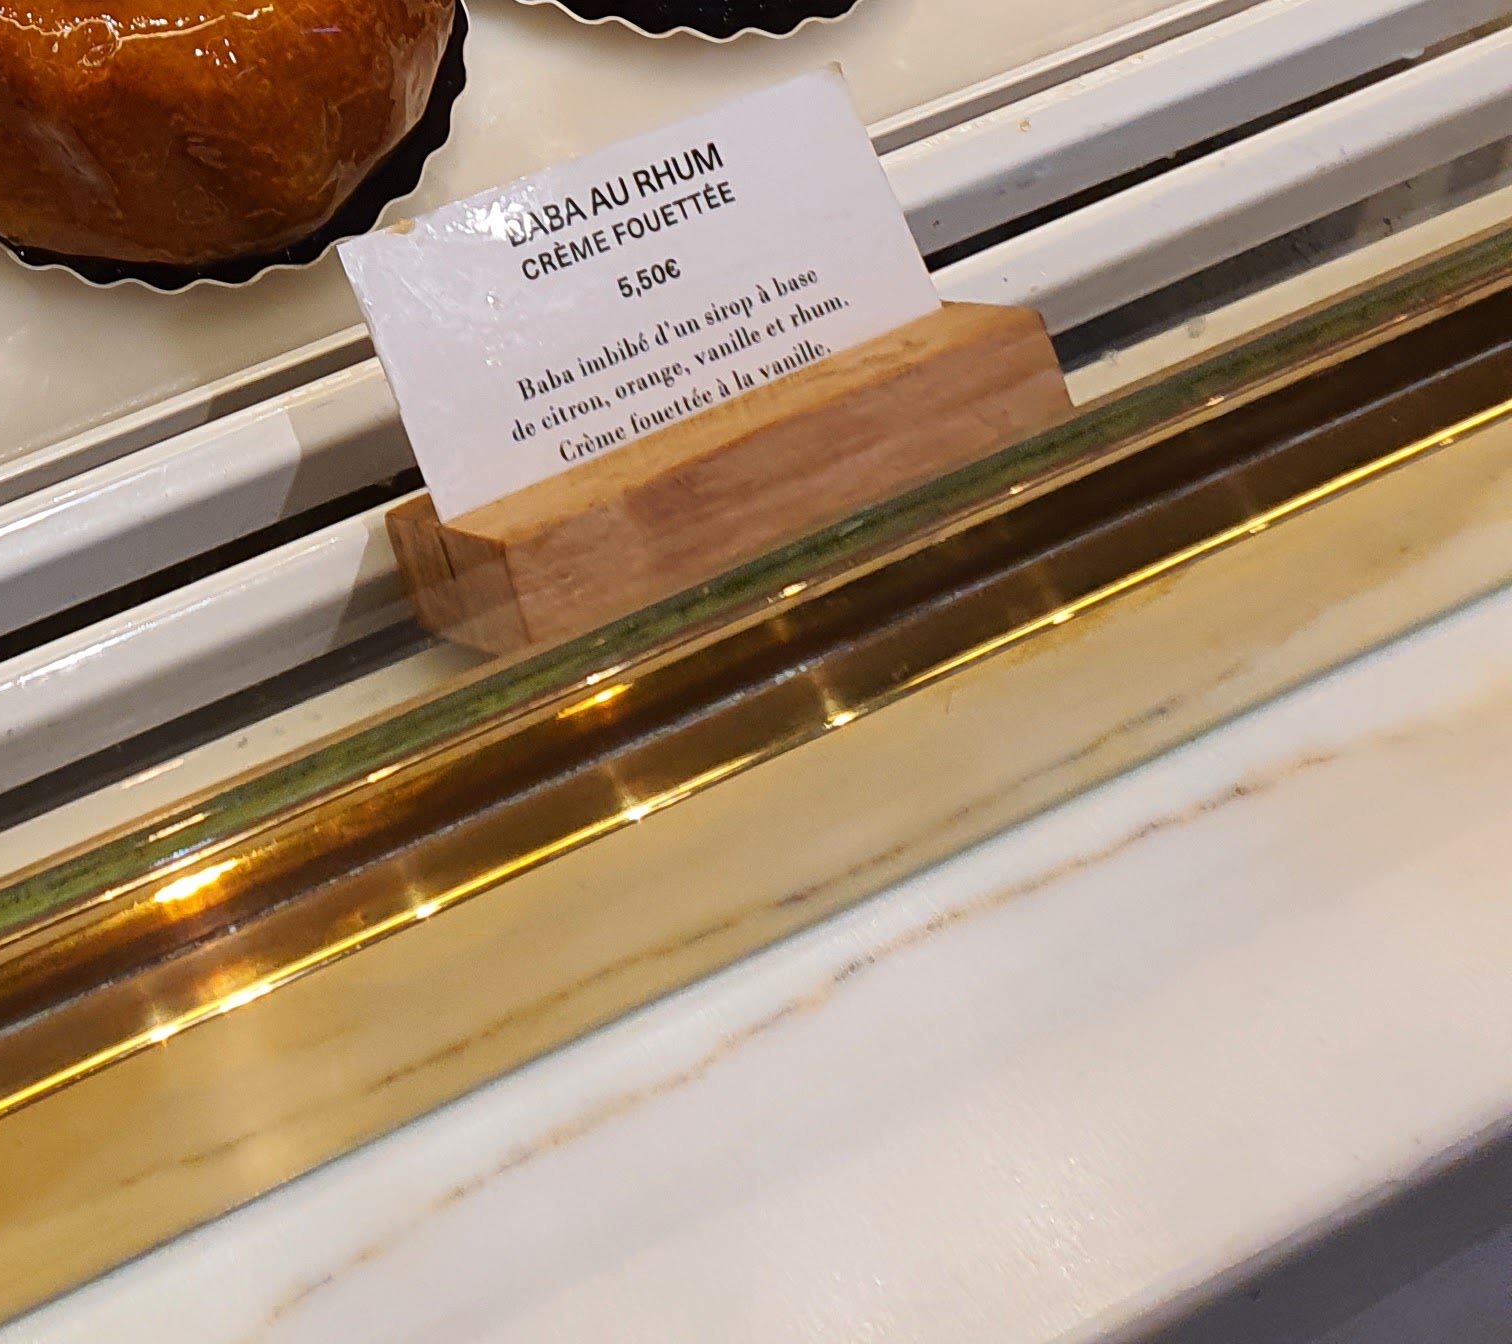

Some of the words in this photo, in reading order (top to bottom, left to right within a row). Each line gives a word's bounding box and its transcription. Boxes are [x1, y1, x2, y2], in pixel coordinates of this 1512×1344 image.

[521, 230, 611, 281] CRÈME
[612, 181, 737, 246] FOUETTÉE
[591, 176, 630, 216] AU
[633, 142, 724, 198] RHUM
[617, 258, 682, 299] 5,50€
[511, 419, 537, 442] de
[541, 395, 612, 431] citron,
[615, 362, 691, 400] orange,
[694, 326, 761, 366] vanille
[766, 317, 786, 338] et
[789, 295, 850, 328] rhum.
[516, 368, 575, 402] Baba
[577, 332, 650, 378] imbibé
[654, 318, 701, 346] d'un
[704, 295, 753, 326] sirop
[755, 283, 771, 304] à
[772, 269, 819, 297] base
[559, 425, 627, 462] Crème
[630, 386, 714, 434] fouettée
[716, 378, 732, 398] à
[732, 369, 755, 391] la
[758, 340, 832, 380] vanille.
